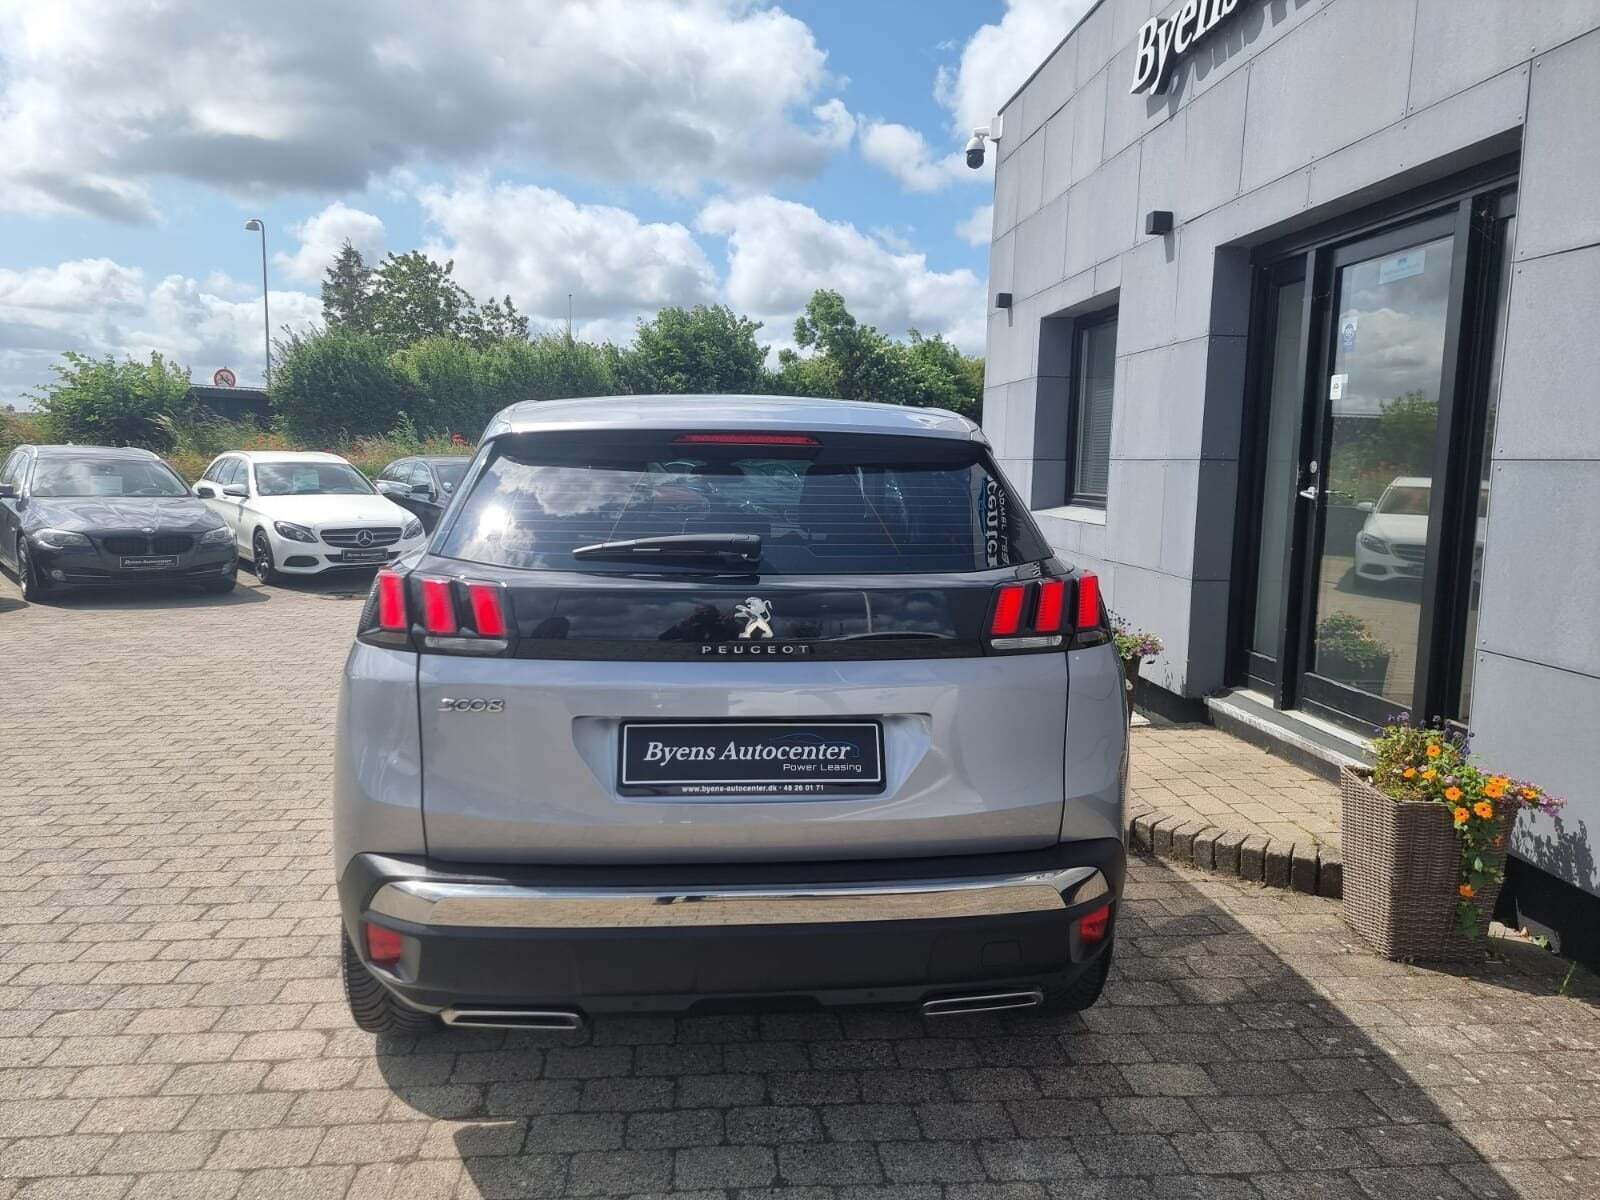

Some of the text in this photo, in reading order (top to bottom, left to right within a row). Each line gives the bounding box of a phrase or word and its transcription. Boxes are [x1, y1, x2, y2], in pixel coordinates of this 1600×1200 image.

[701, 645, 809, 655] PEUGEOT
[437, 696, 505, 713] 3008
[643, 741, 851, 766] Byens Autocenter
[783, 763, 862, 773] Power Leasing
[681, 785, 778, 794] www.byens-autocenter.dk
